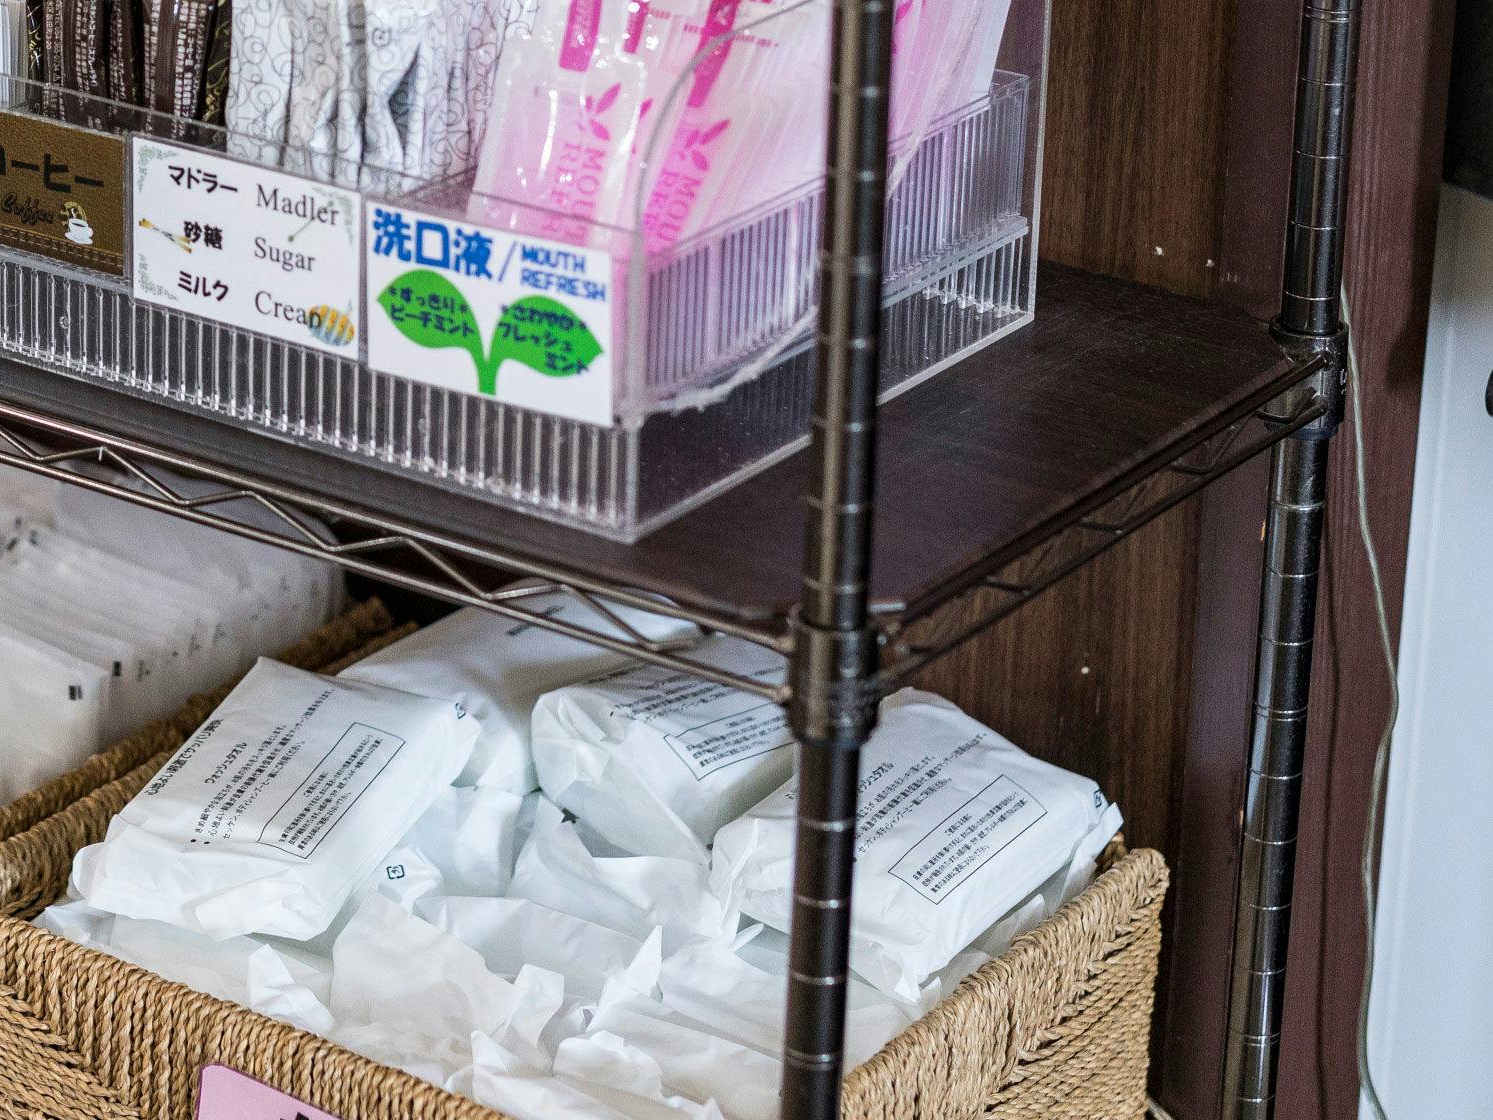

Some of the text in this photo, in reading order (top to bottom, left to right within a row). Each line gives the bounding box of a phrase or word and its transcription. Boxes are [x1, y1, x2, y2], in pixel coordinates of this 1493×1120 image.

[0, 191, 55, 226] Coffee
[168, 164, 339, 226] マドラー Madler
[183, 220, 316, 273] 砂糖 Sugar
[521, 243, 587, 274] MOUTH
[177, 270, 229, 302] ミルク
[520, 267, 606, 302] REFRESH
